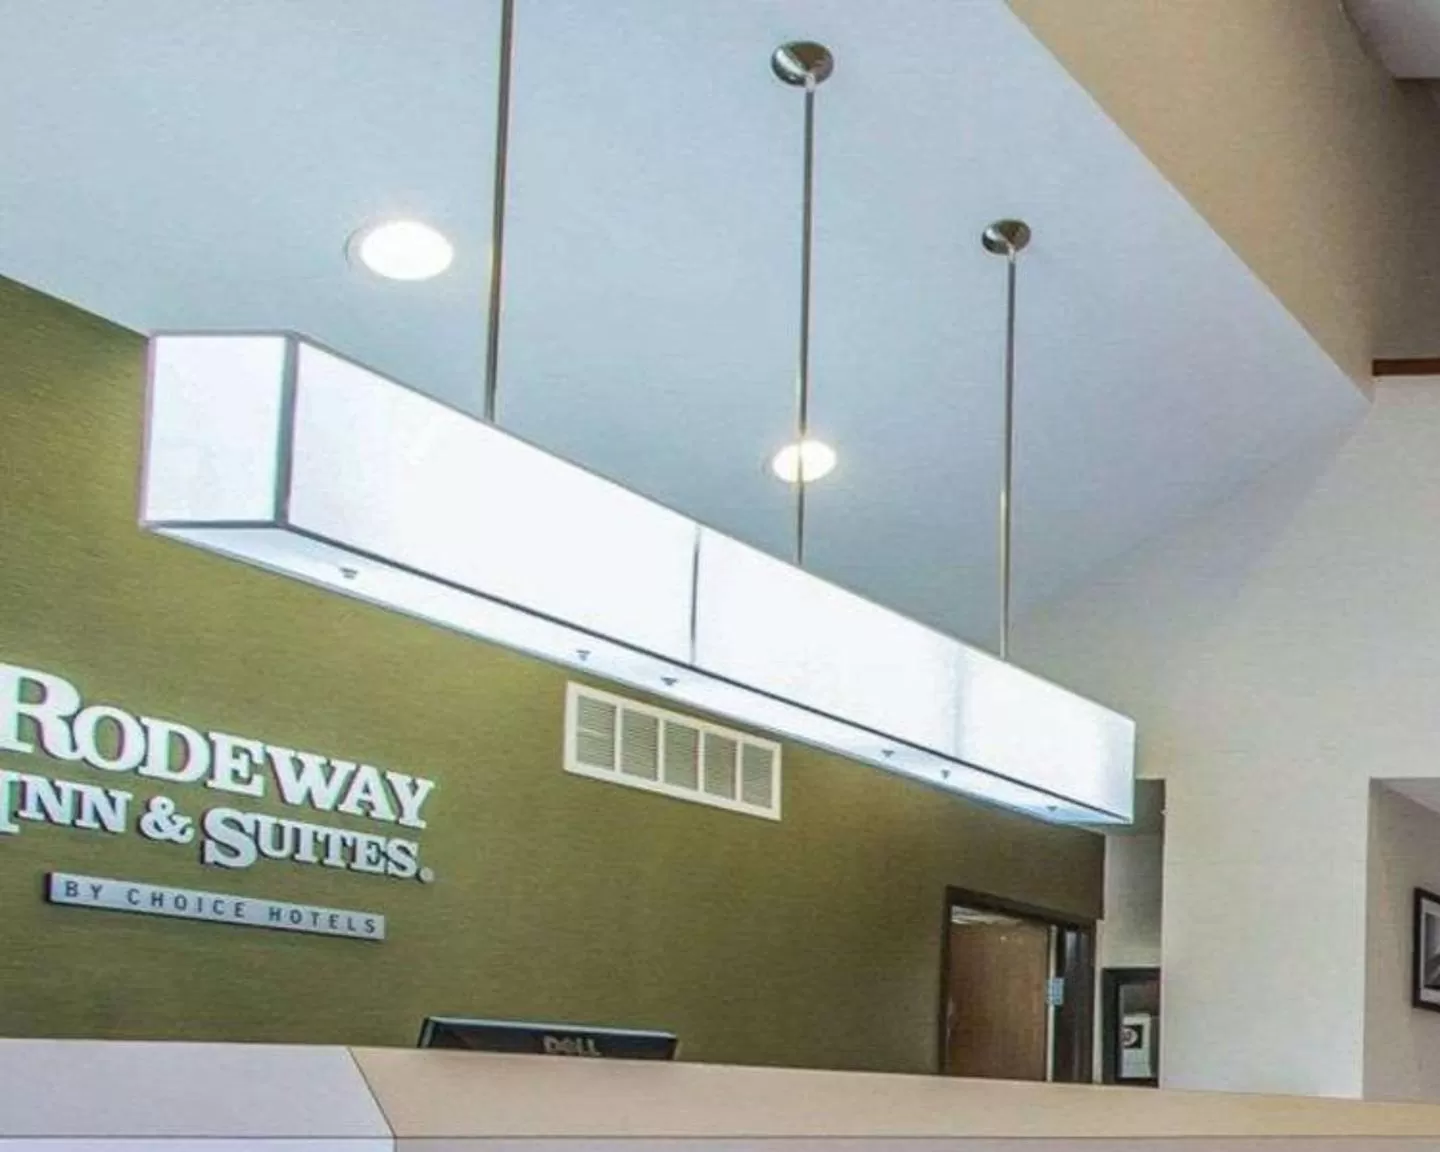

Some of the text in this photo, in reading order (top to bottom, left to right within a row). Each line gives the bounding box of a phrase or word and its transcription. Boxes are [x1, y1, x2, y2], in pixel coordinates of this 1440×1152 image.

[0, 662, 435, 829] RODEWAY
[140, 795, 195, 844] &
[65, 880, 377, 935] BY CHOICE HOTELS
[543, 1035, 603, 1057] DELL
